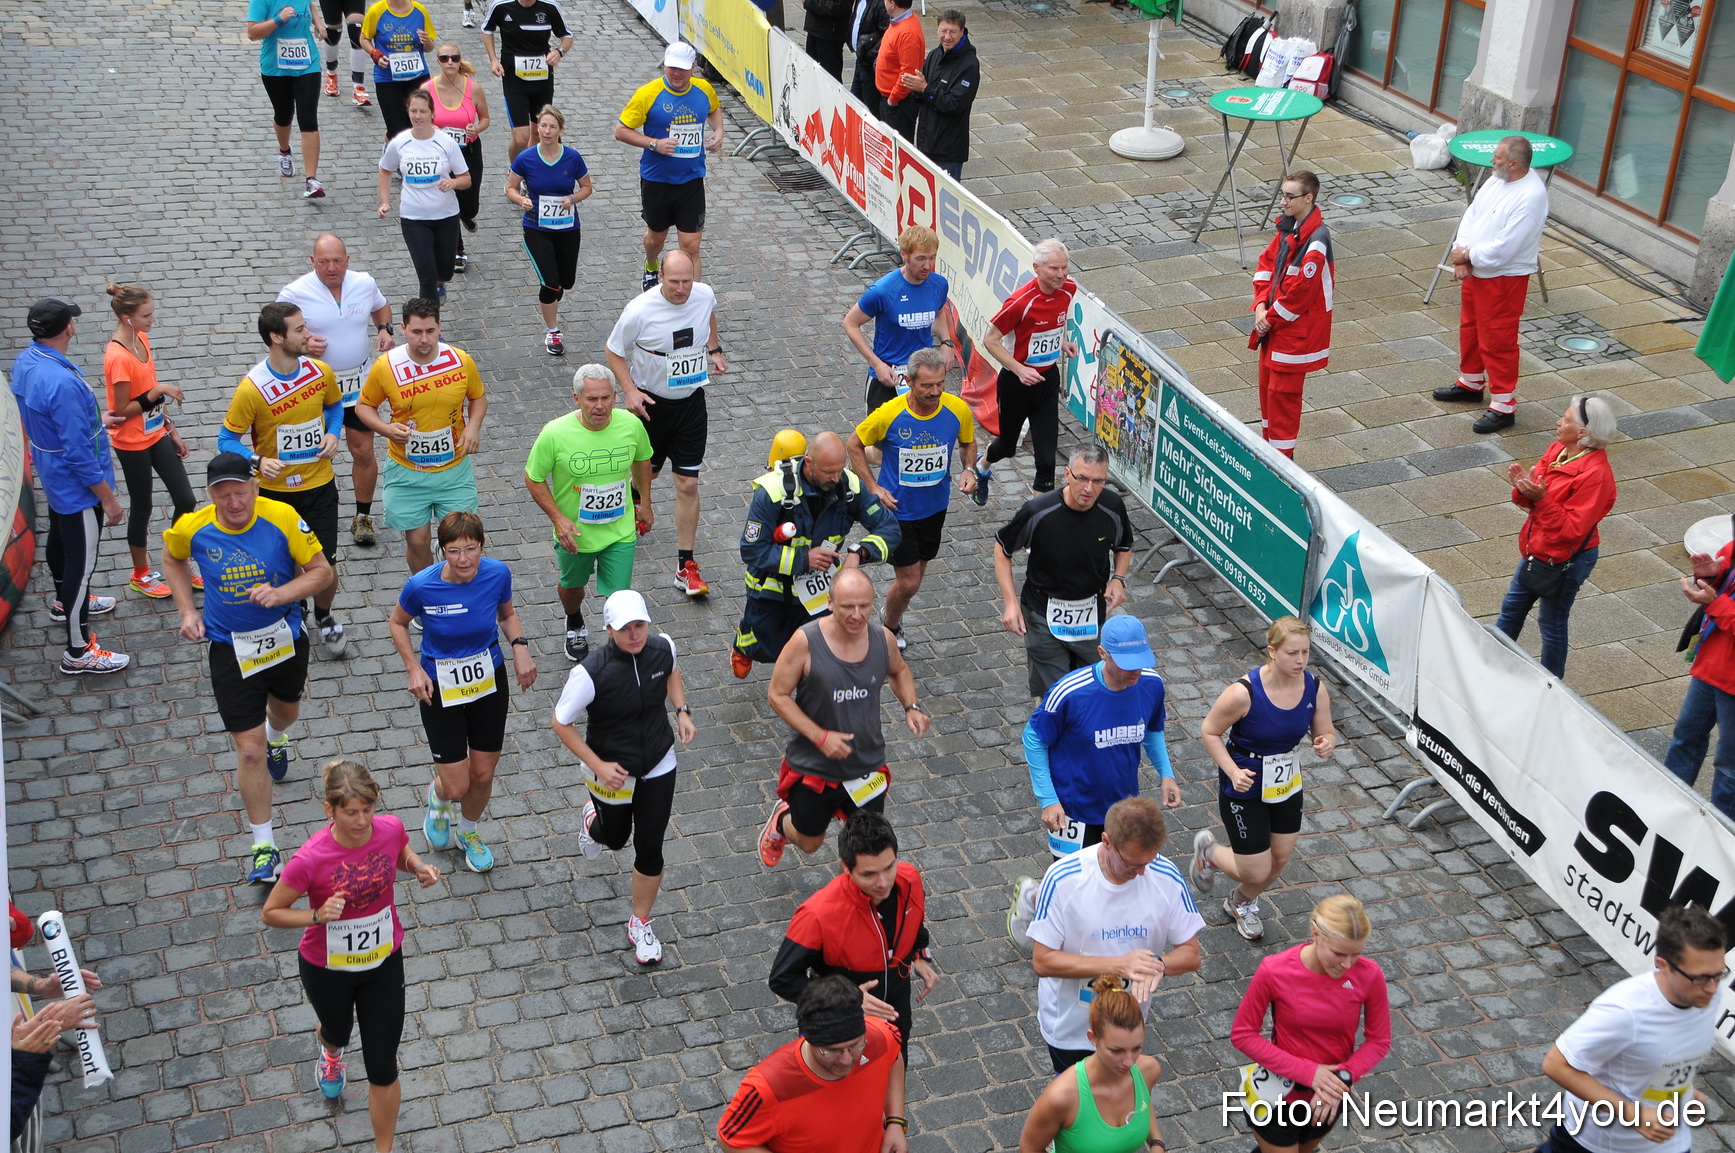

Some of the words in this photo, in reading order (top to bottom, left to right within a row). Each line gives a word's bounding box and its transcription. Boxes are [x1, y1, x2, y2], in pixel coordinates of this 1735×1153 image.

[281, 46, 307, 58] 2508
[394, 59, 419, 73] 2507
[522, 58, 542, 70] 172
[406, 161, 438, 175] 2657
[846, 152, 865, 192] Braun
[898, 310, 936, 323] HUBER
[1032, 336, 1060, 355] 2613
[671, 355, 704, 376] 2077
[400, 383, 430, 400] MAX
[434, 371, 467, 389] BÖGL
[676, 376, 702, 385] Wolfgang
[271, 397, 299, 417] MAX
[300, 380, 328, 401] BÖGL
[283, 428, 322, 451] 2195
[410, 436, 450, 454] 2545
[1183, 414, 1252, 481] Event-Leit-Systeme
[568, 445, 630, 475] OPF
[904, 456, 944, 473] 2264
[1161, 435, 1192, 475] Mehr
[1194, 463, 1253, 531] Sicherheit
[585, 491, 623, 510] 2323
[1159, 461, 1174, 489] für
[1178, 479, 1195, 506] Ihr
[1197, 495, 1235, 543] Event!
[592, 511, 615, 519] Helmut
[1157, 496, 1174, 521] Miet
[1174, 511, 1180, 524] &
[1181, 518, 1206, 548] Service
[1206, 543, 1224, 566] Line:
[1224, 559, 1247, 588] 09181
[1247, 580, 1267, 607] 6352
[805, 571, 832, 596] 666
[1052, 606, 1094, 625] 2577
[234, 633, 252, 641] PARTL
[254, 627, 280, 639] Neumarkt
[1057, 627, 1087, 635] Reinhard
[252, 637, 276, 655] 73
[253, 650, 281, 666] Richard
[436, 658, 456, 667] PARTL
[457, 653, 483, 665] Neumarkt
[449, 662, 485, 685] 106
[1344, 647, 1368, 674] Service
[1368, 665, 1391, 691] GmbH
[460, 687, 480, 696] Erika
[1094, 723, 1146, 743] HUBER
[868, 774, 885, 790] Thilo
[594, 785, 616, 798] Marga
[1465, 772, 1482, 794] die
[1482, 787, 1531, 845] verbinden
[353, 917, 384, 930] Neumarkt
[342, 926, 380, 952] 121
[1101, 925, 1148, 941] heinloth
[346, 951, 379, 964] Claudia
[51, 947, 79, 992] BMW
